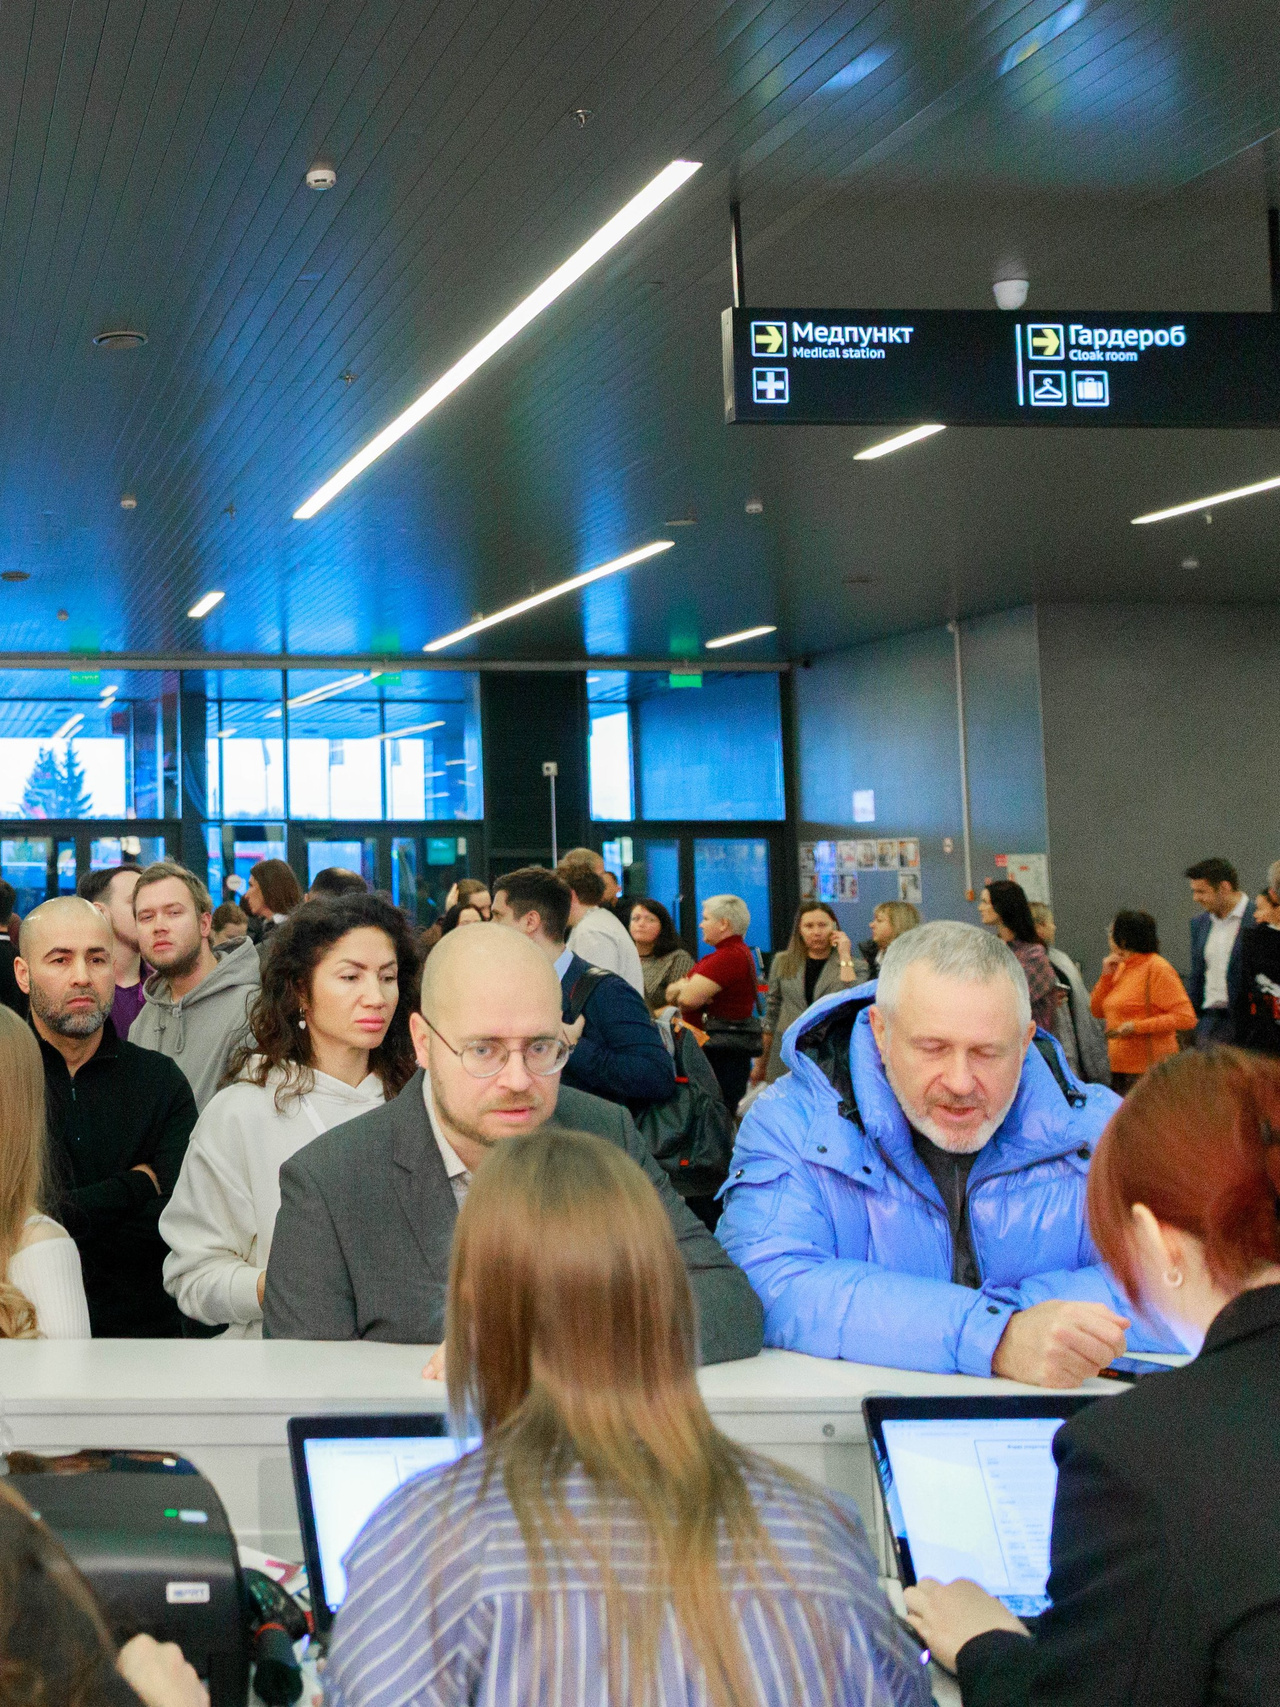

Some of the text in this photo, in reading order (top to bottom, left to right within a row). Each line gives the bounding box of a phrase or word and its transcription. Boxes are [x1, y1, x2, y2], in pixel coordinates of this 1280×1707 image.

[792, 321, 914, 347] Медпункт
[1069, 323, 1186, 351] Гардероб
[792, 347, 886, 359] Medical station
[1069, 349, 1138, 361] Cloak room
